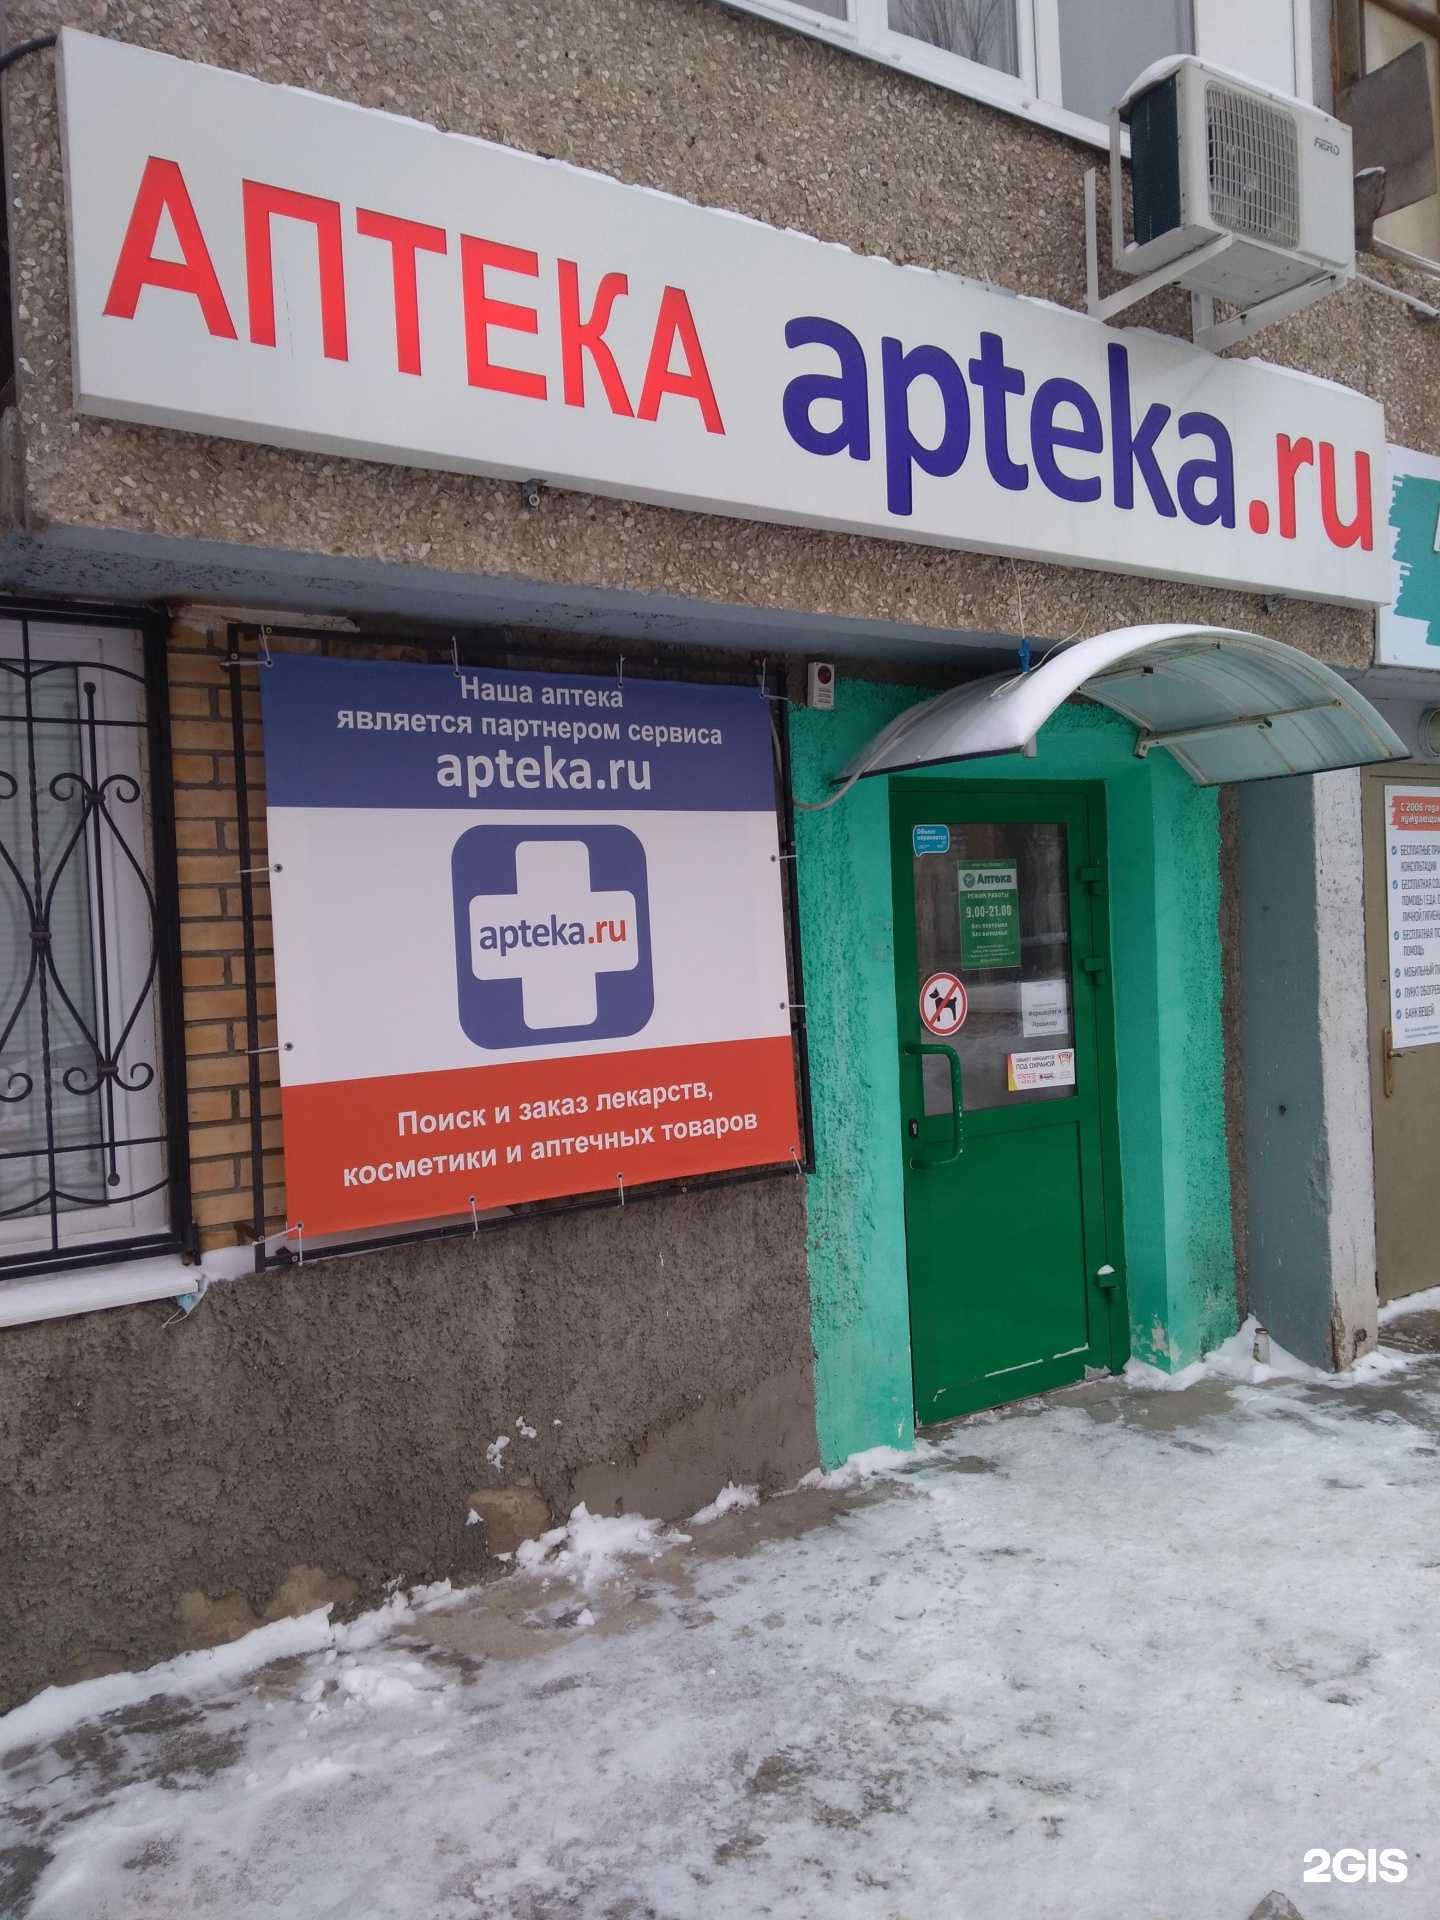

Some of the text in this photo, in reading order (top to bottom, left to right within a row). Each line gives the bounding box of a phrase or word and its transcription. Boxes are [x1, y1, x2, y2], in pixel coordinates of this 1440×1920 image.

[103, 155, 1374, 551] АПТЕКА apteka.ru
[460, 675, 623, 708] Наша аптека
[337, 710, 722, 747] является партнером сервиса
[436, 745, 651, 798] apteka.ru
[977, 874, 1012, 884] Аптека
[479, 914, 626, 957] apteka.ru
[398, 1081, 713, 1137] Поиск и заказ лекарств,
[343, 1113, 758, 1187] косметики и аптечных товаров
